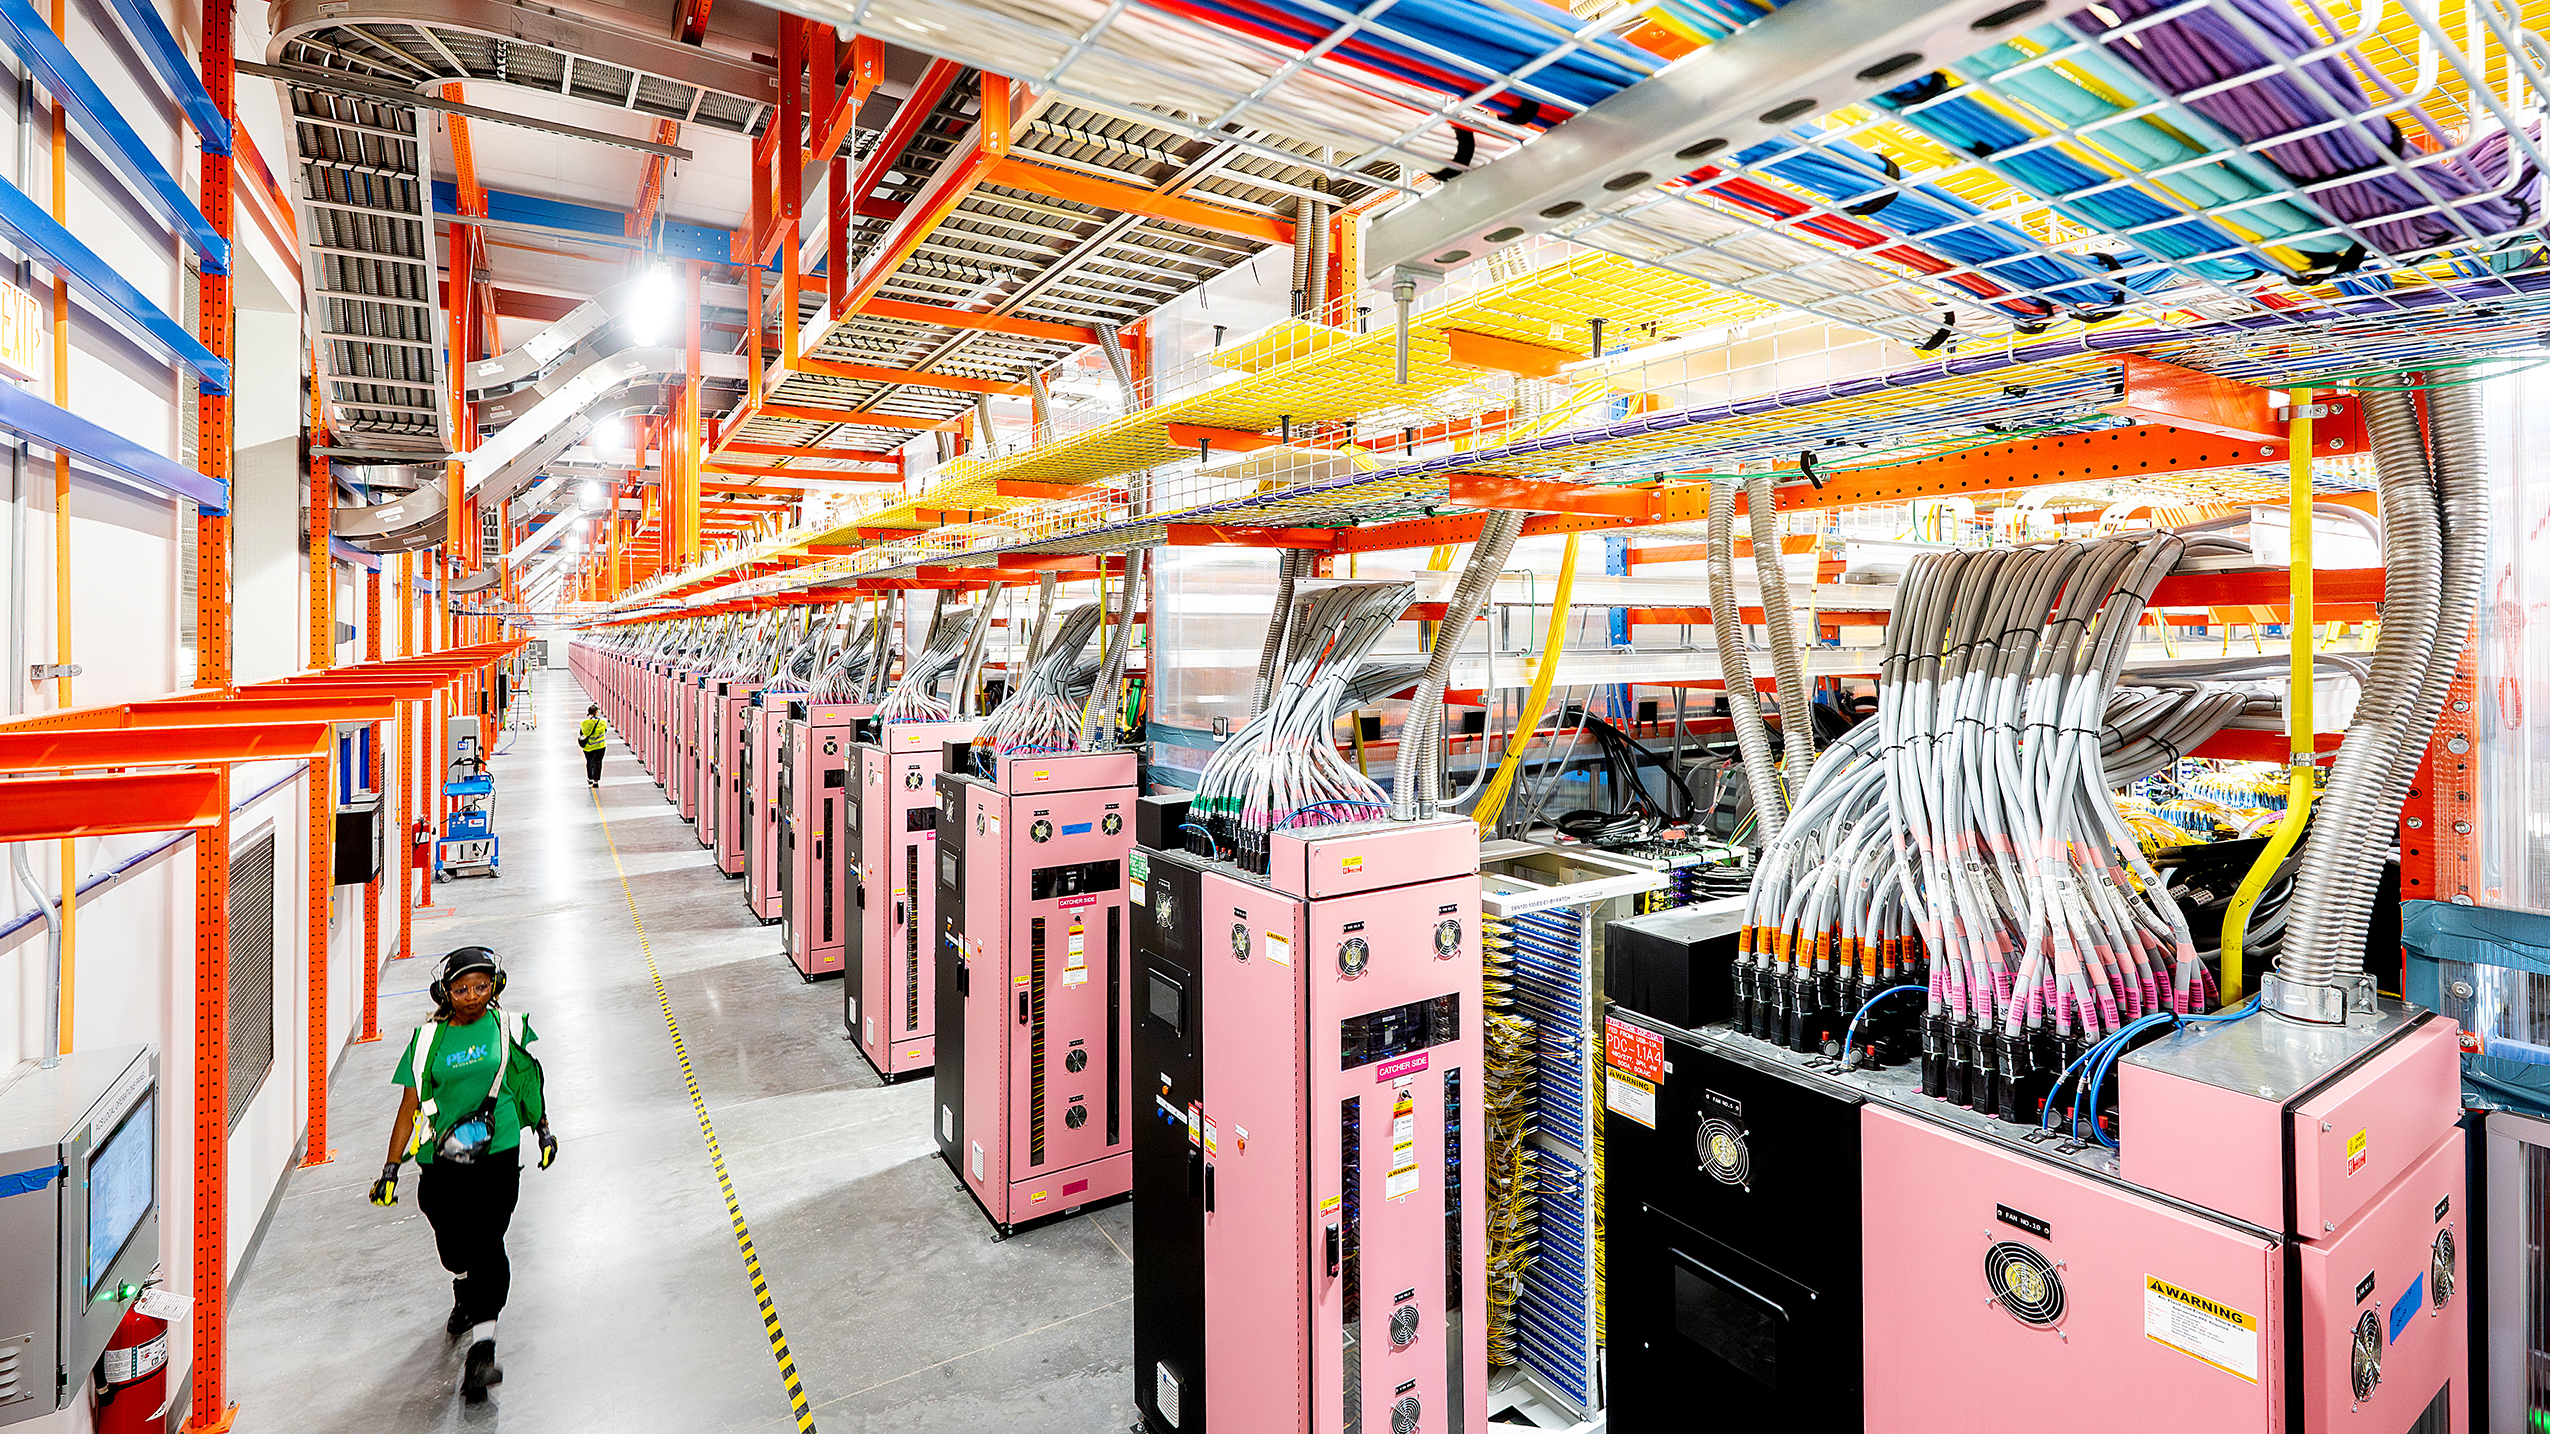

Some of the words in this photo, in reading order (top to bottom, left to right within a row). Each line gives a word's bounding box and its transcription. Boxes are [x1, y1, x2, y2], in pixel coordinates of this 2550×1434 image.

[1, 281, 37, 371] EXIT
[1059, 899, 1083, 907] CATCHER
[1608, 1025, 1618, 1034] FED
[446, 1043, 488, 1067] PEAK
[1606, 1033, 1662, 1066] PDC-1.1A4
[1379, 1061, 1411, 1076] CATCHER
[1411, 1056, 1428, 1068] SIDE
[1648, 1064, 1658, 1072] 4W
[1614, 1071, 1650, 1091] WARNING
[1712, 1096, 1721, 1105] FAN
[1392, 1164, 1416, 1176] WARNING
[2005, 1211, 2018, 1223] FAN
[2020, 1217, 2042, 1231] NO.10
[2165, 1285, 2243, 1324] WARNING
